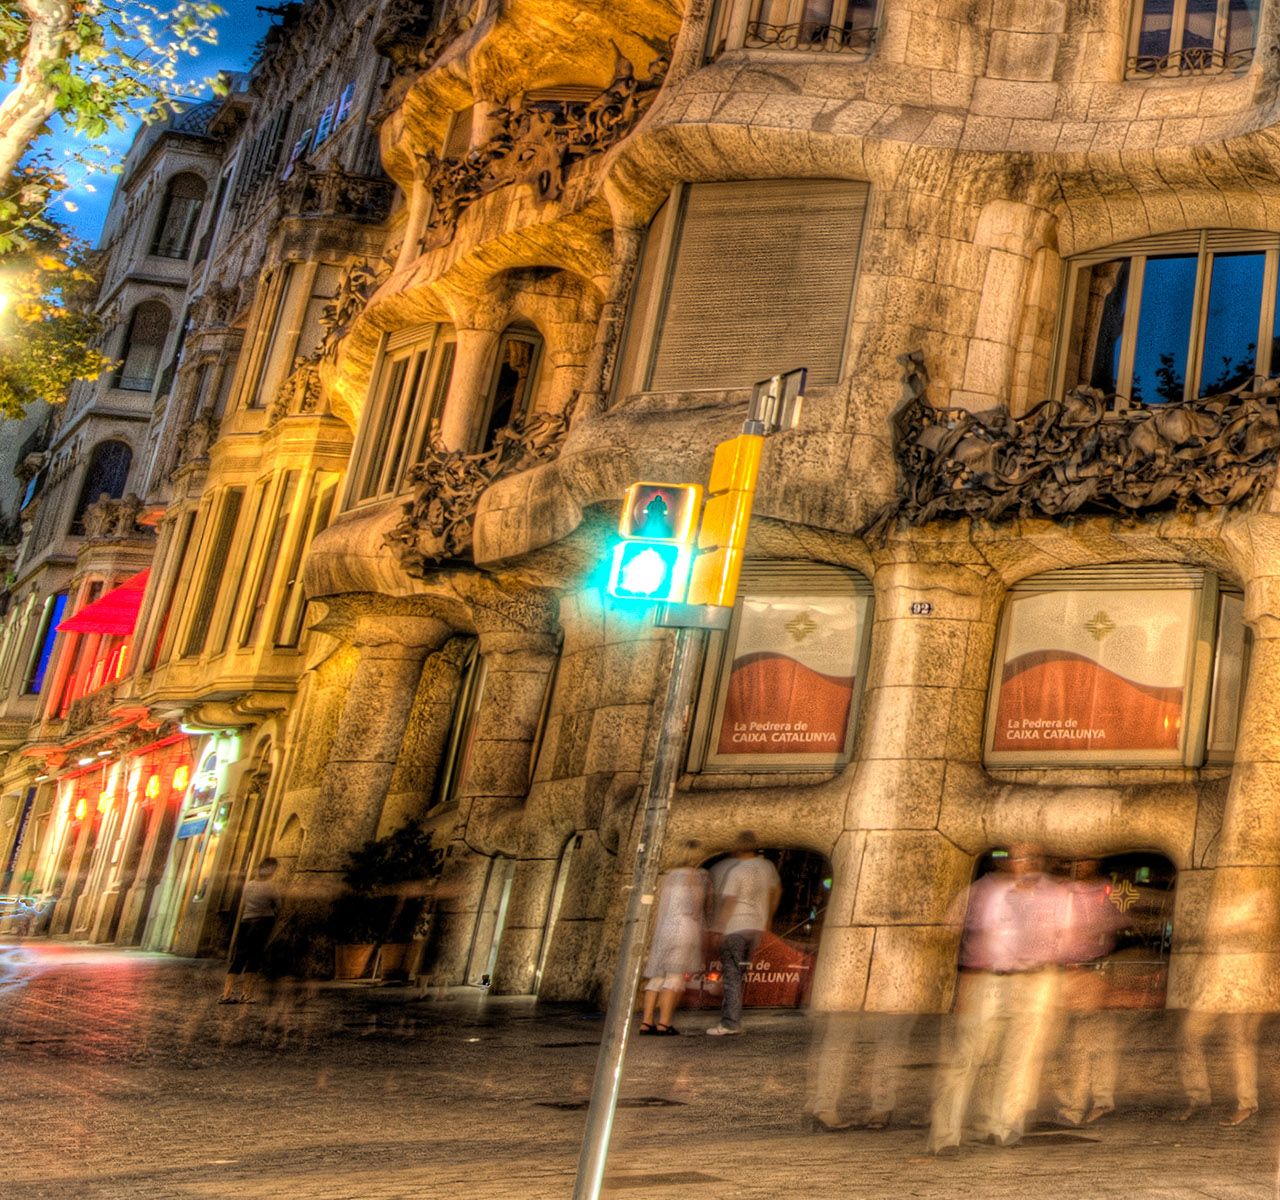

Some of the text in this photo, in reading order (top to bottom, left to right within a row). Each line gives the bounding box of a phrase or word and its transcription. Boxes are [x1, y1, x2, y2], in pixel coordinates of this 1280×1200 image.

[912, 603, 930, 614] 92
[734, 720, 809, 732] La Pedrera de
[1007, 717, 1078, 729] La Pedrera de
[732, 732, 837, 743] CAIXA CATALUNYA
[1006, 729, 1106, 740] CAIXA CATALUNYA
[755, 959, 771, 972] de
[742, 972, 801, 983] ATALUNYA
